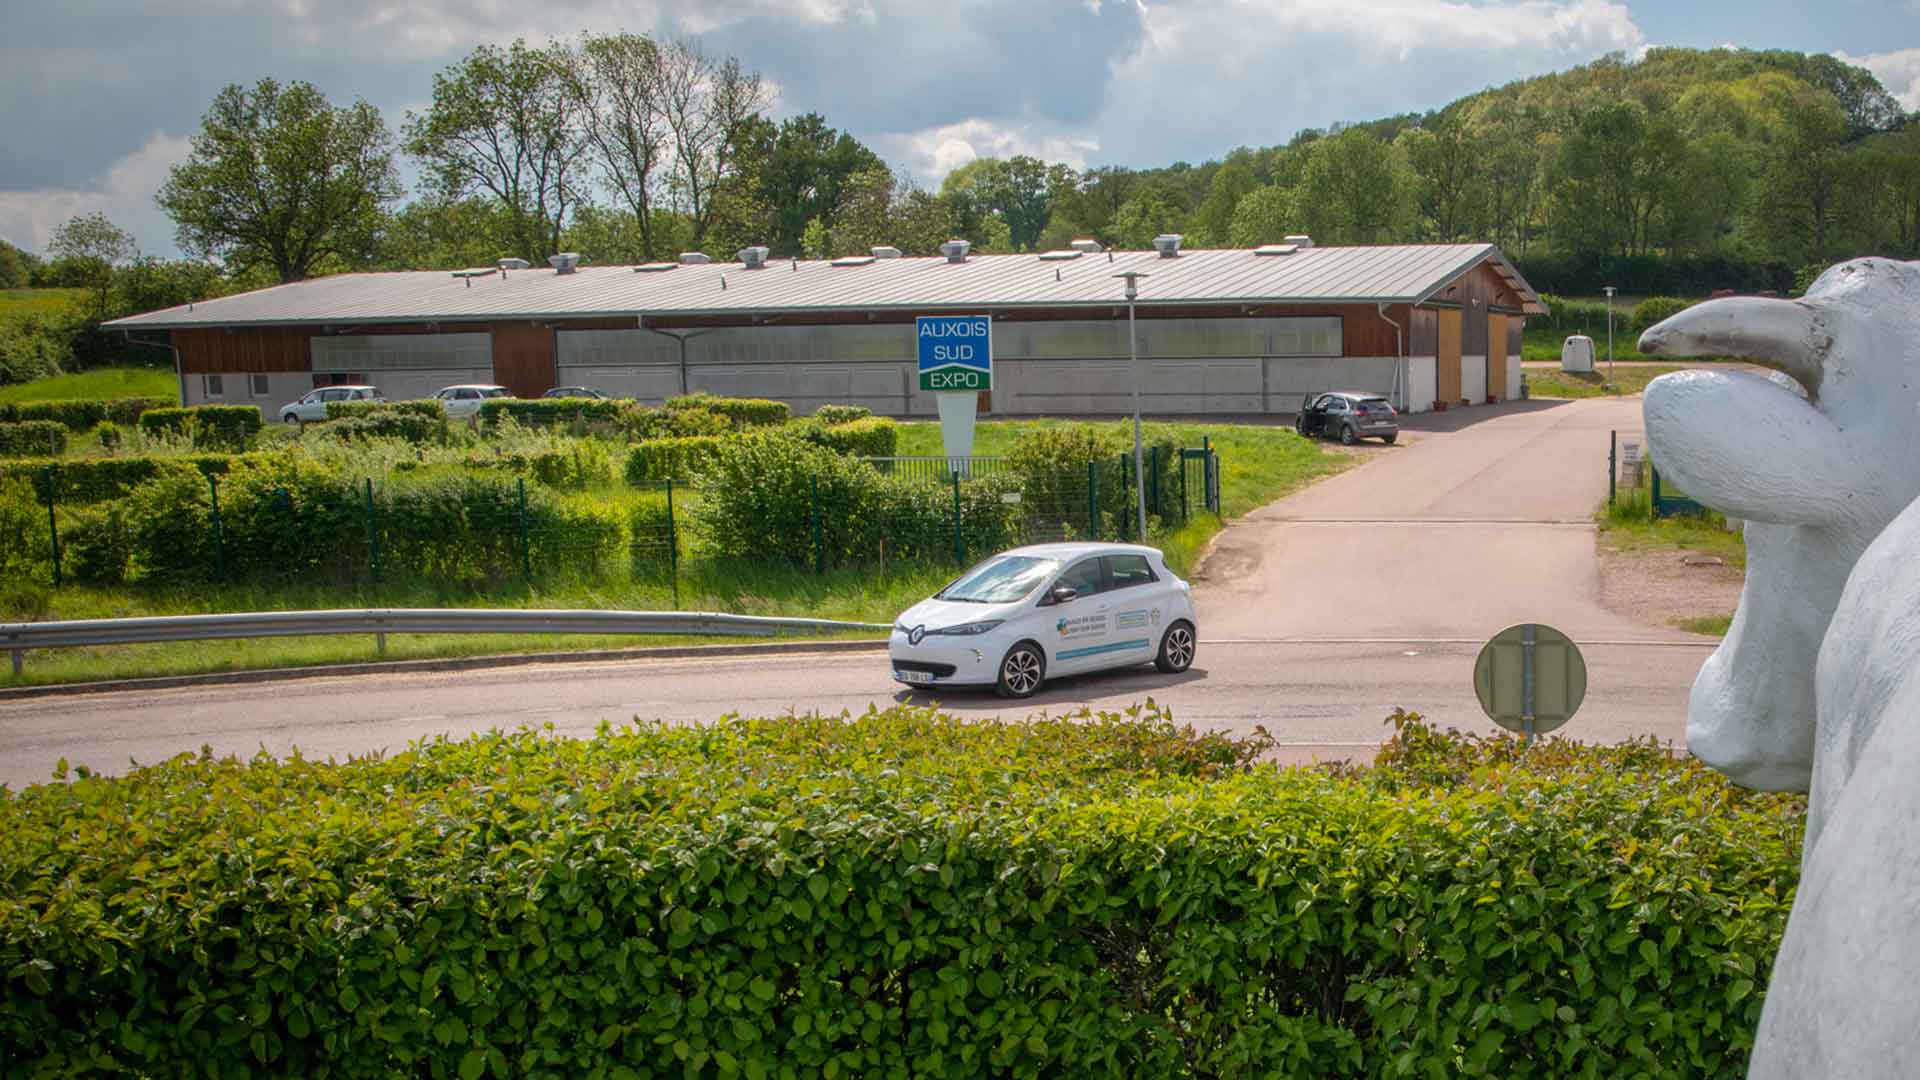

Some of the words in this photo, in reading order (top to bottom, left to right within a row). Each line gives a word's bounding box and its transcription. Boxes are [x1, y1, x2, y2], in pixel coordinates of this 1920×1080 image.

[920, 322, 986, 337] AUXOIS
[934, 345, 973, 360] SUD
[930, 372, 978, 388] EXPO
